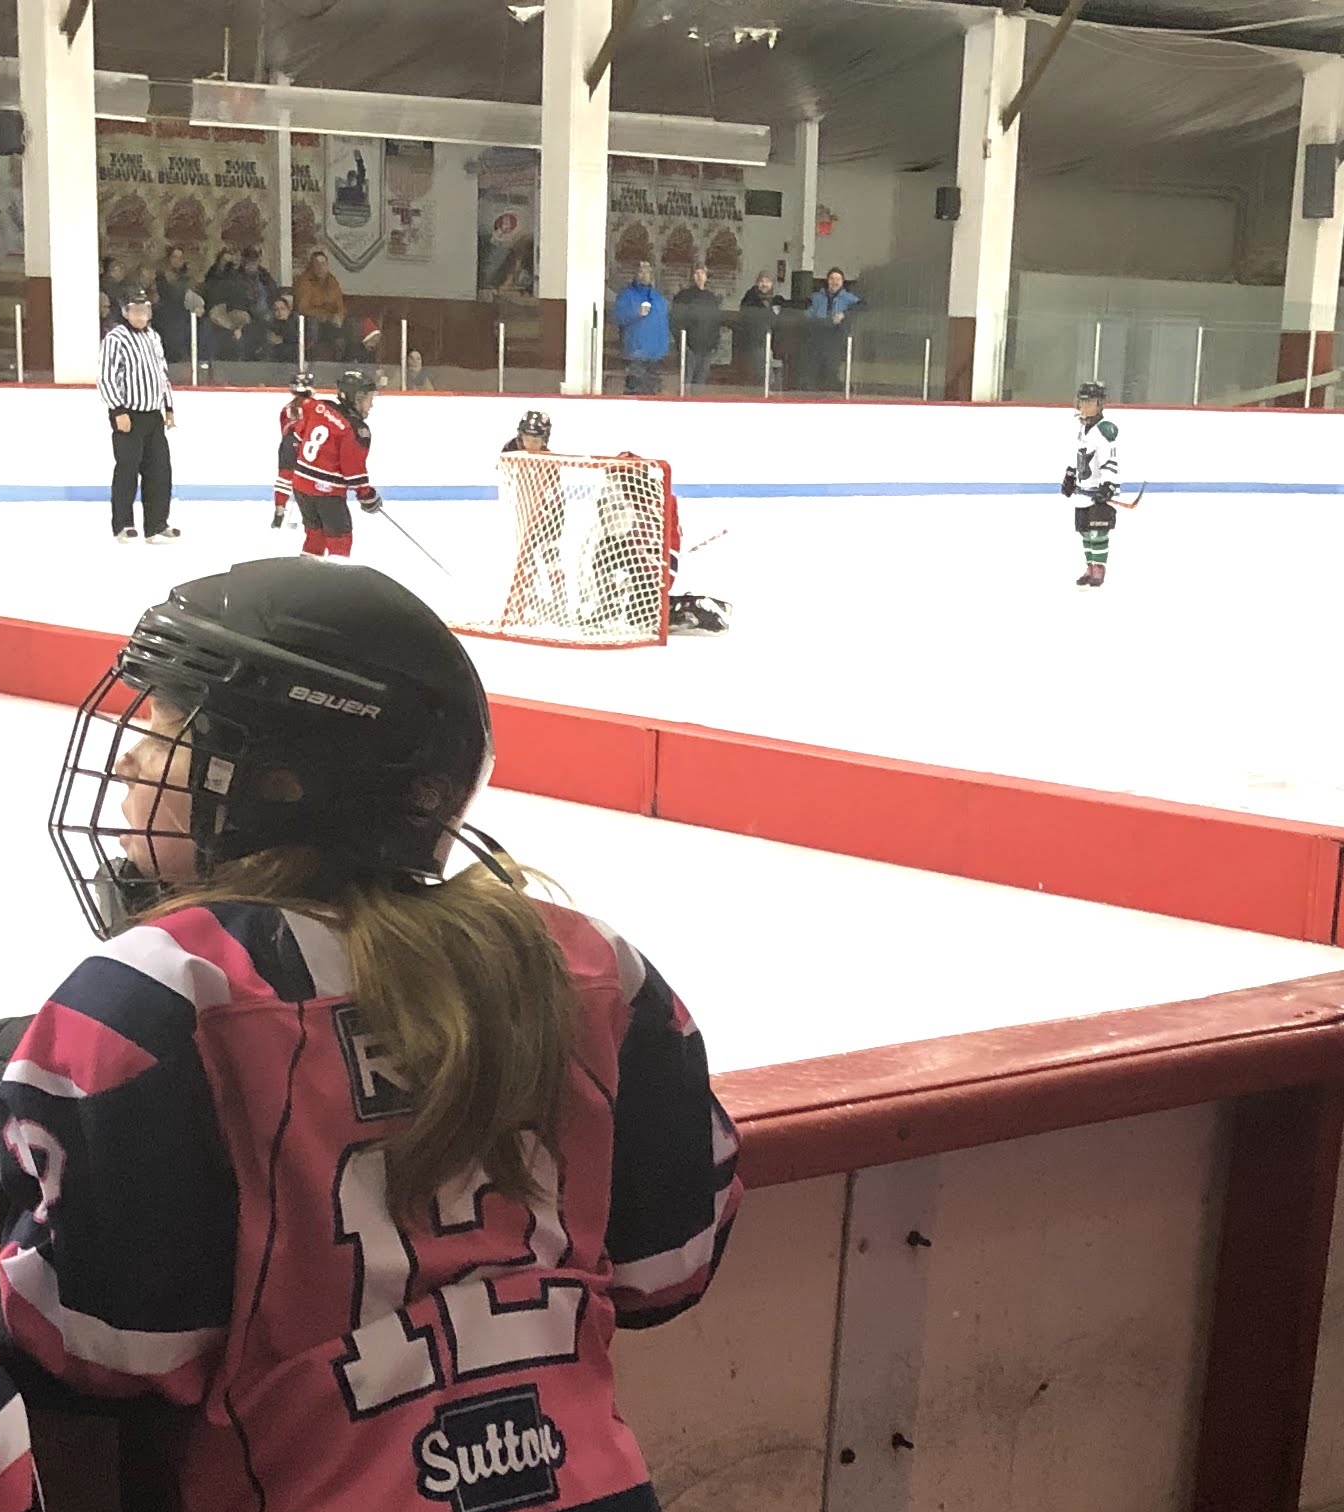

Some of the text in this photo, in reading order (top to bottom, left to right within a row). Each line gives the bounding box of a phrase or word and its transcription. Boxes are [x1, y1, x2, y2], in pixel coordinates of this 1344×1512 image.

[303, 425, 330, 462] 8
[288, 685, 384, 721] BAUER
[420, 1420, 562, 1494] Sutton
